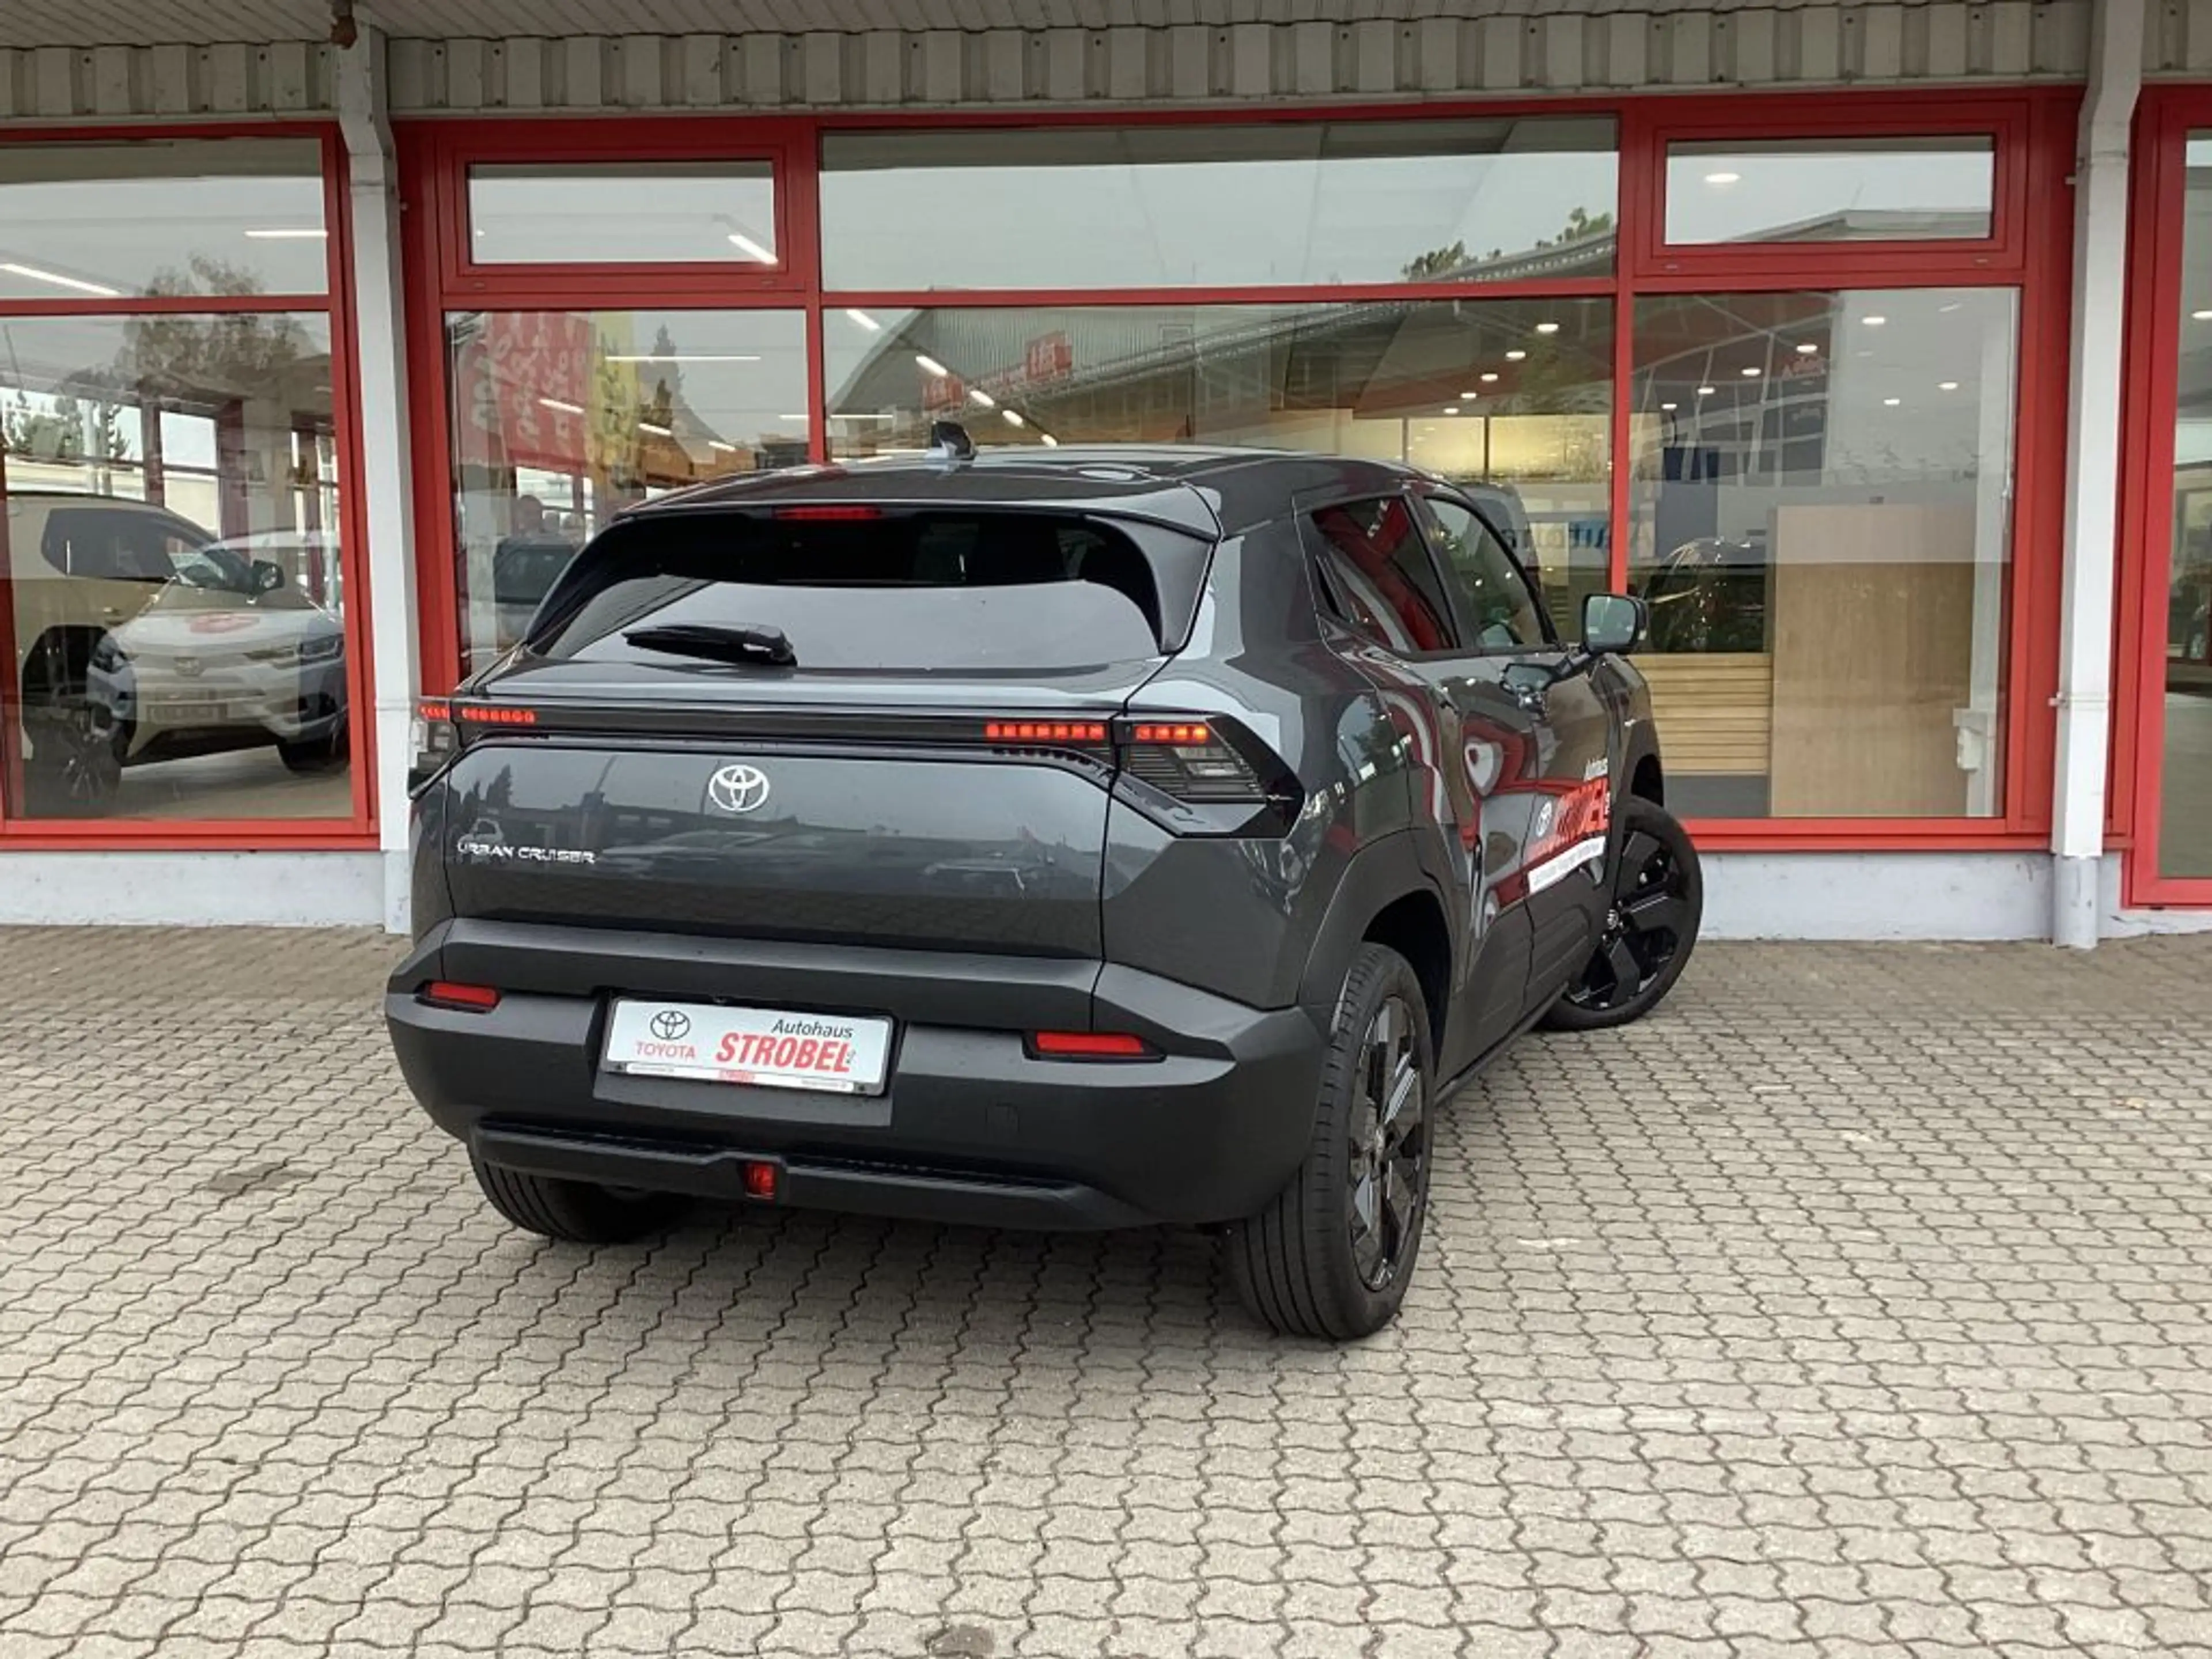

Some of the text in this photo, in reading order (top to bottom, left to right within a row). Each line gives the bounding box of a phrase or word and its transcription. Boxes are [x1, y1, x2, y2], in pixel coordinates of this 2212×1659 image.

[518, 846, 595, 864] CRUISER
[771, 1019, 854, 1039] Autohaus
[636, 1041, 696, 1059] TOYOTA
[716, 1032, 851, 1073] STROBEL
